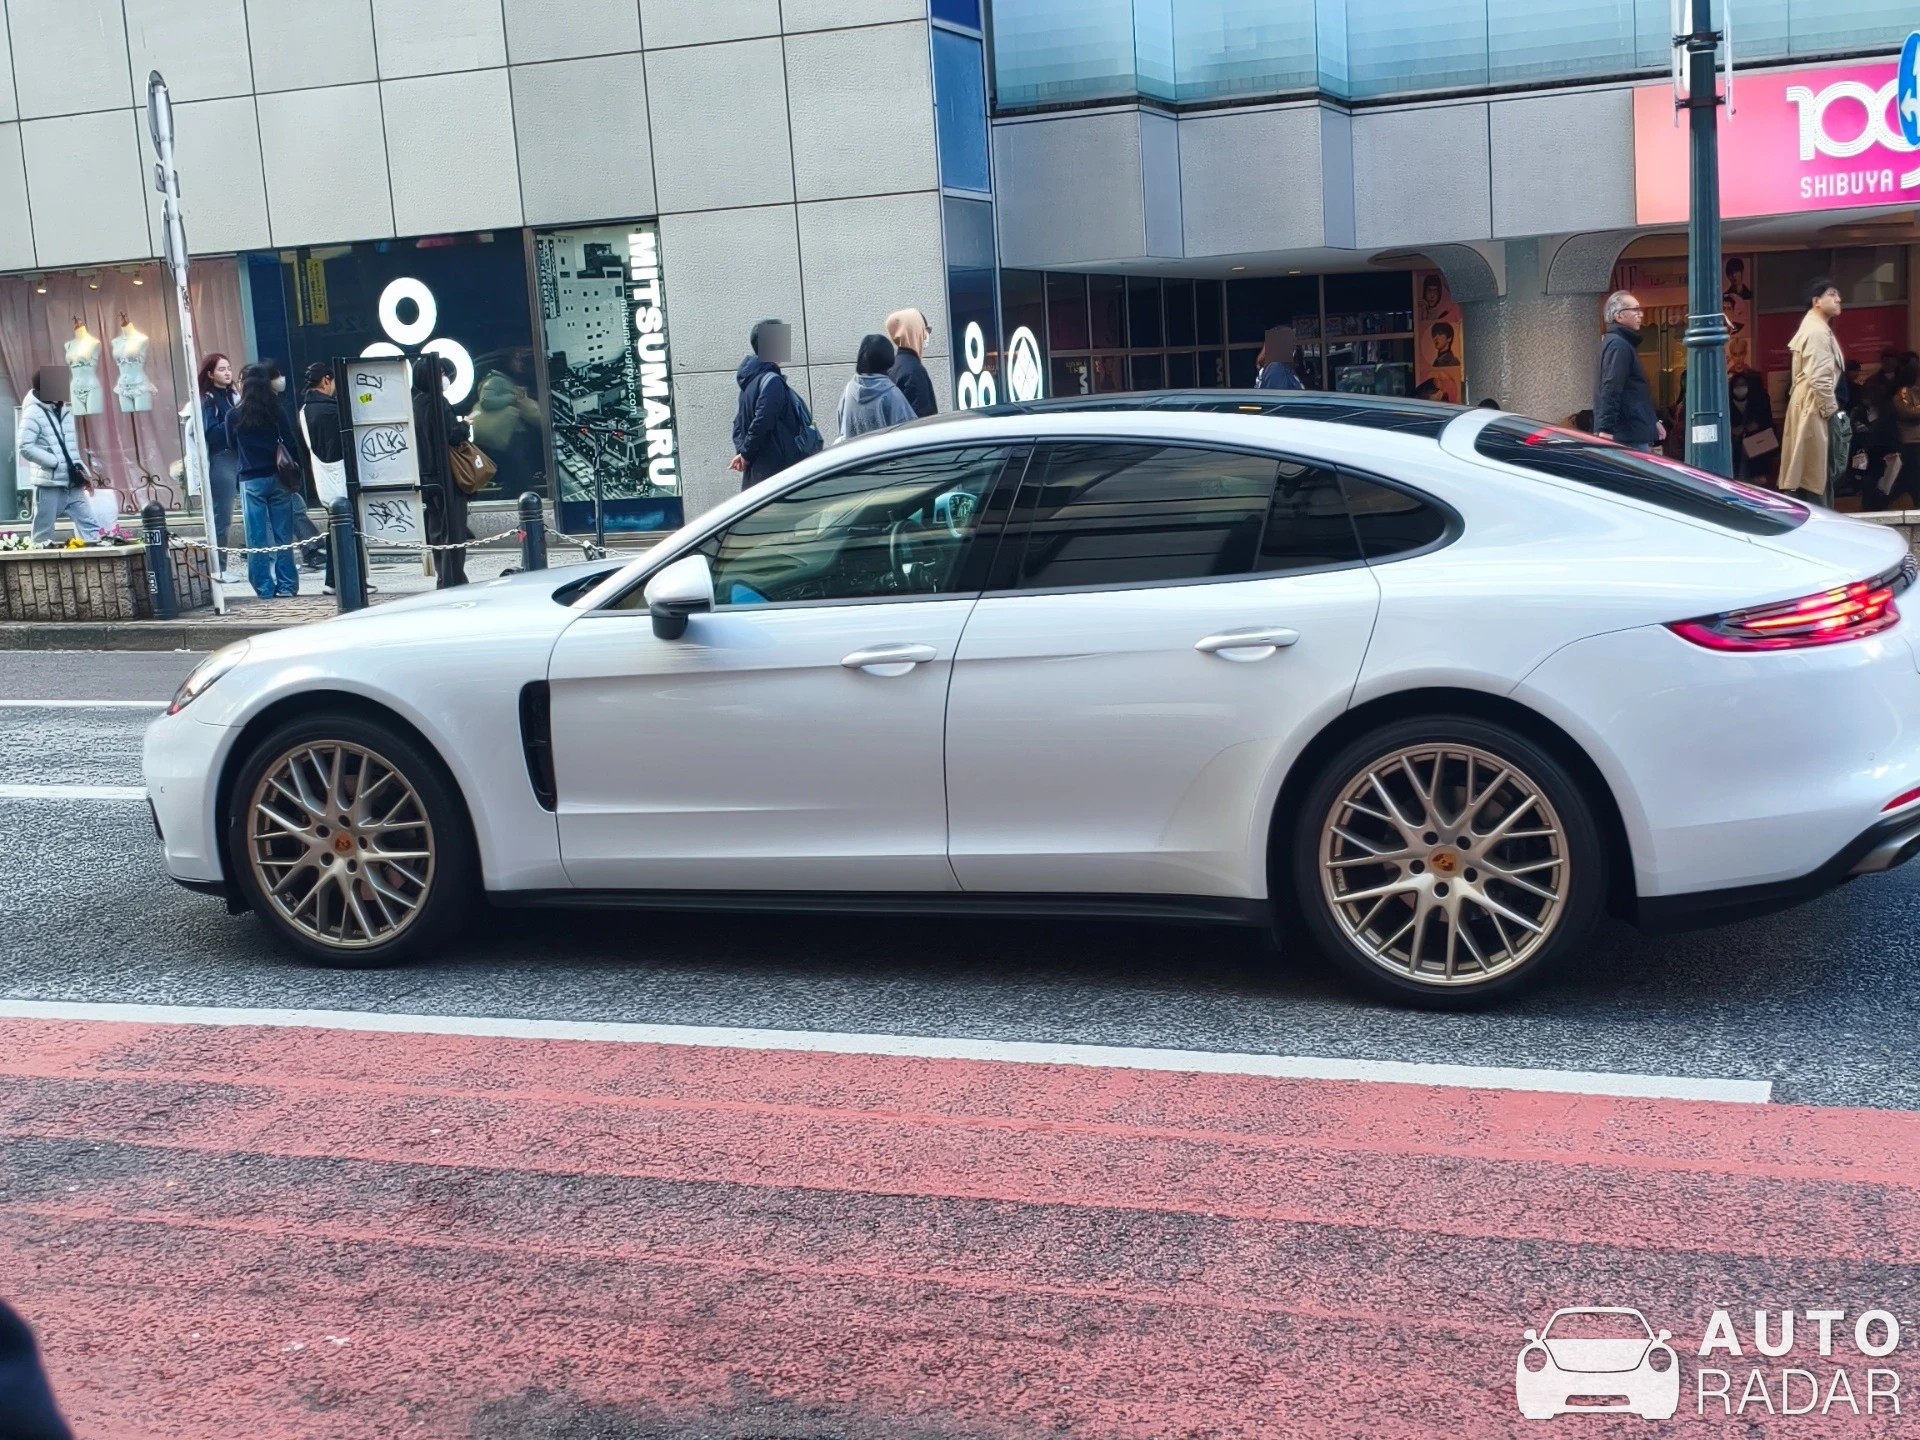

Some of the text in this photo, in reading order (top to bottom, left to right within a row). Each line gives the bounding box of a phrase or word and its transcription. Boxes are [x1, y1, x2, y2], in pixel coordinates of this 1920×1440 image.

[1800, 168, 1894, 199] SHIBUYA
[619, 299, 638, 415] mitsumarugroup.com
[628, 232, 677, 486] MITSUMARU
